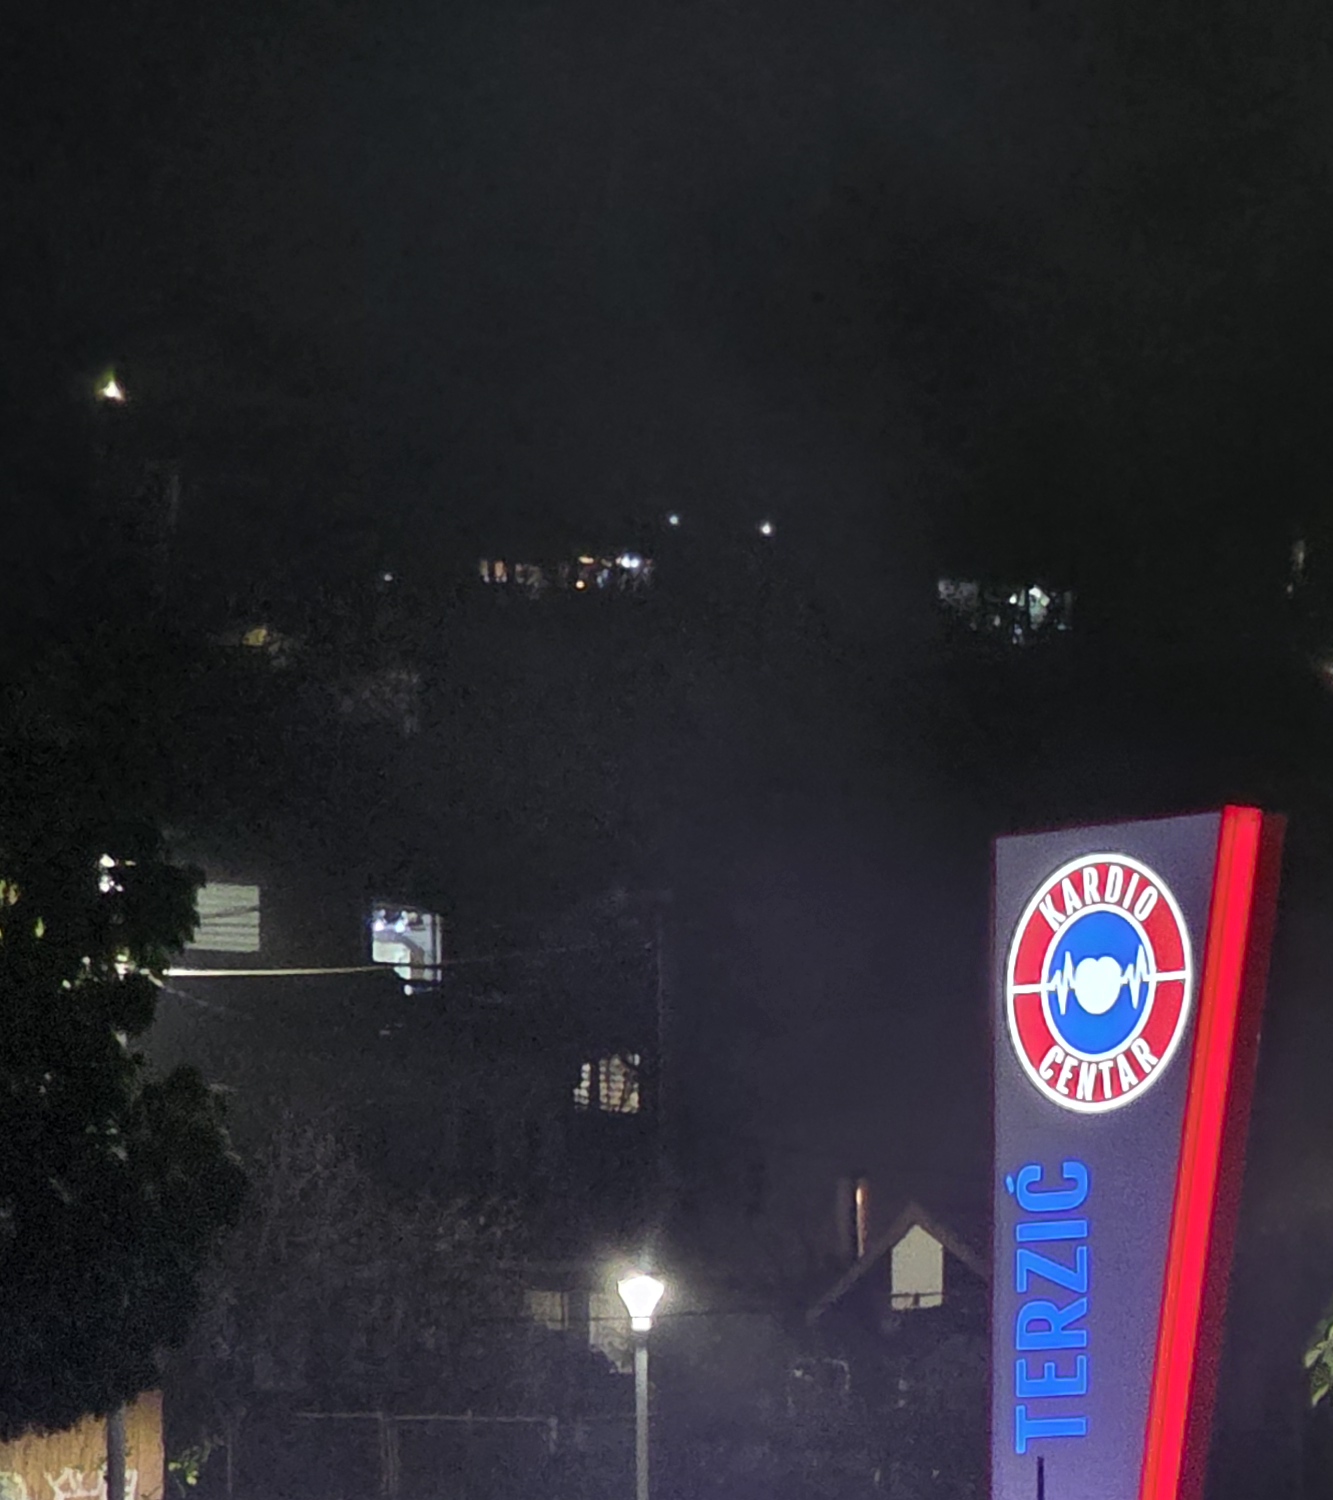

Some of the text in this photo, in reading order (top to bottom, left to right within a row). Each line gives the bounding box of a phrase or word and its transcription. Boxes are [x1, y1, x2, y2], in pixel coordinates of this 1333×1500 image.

[1038, 865, 1159, 932] KARDIO
[1038, 1037, 1159, 1101] CENTAR
[1005, 1161, 1088, 1454] TERZIĆ
